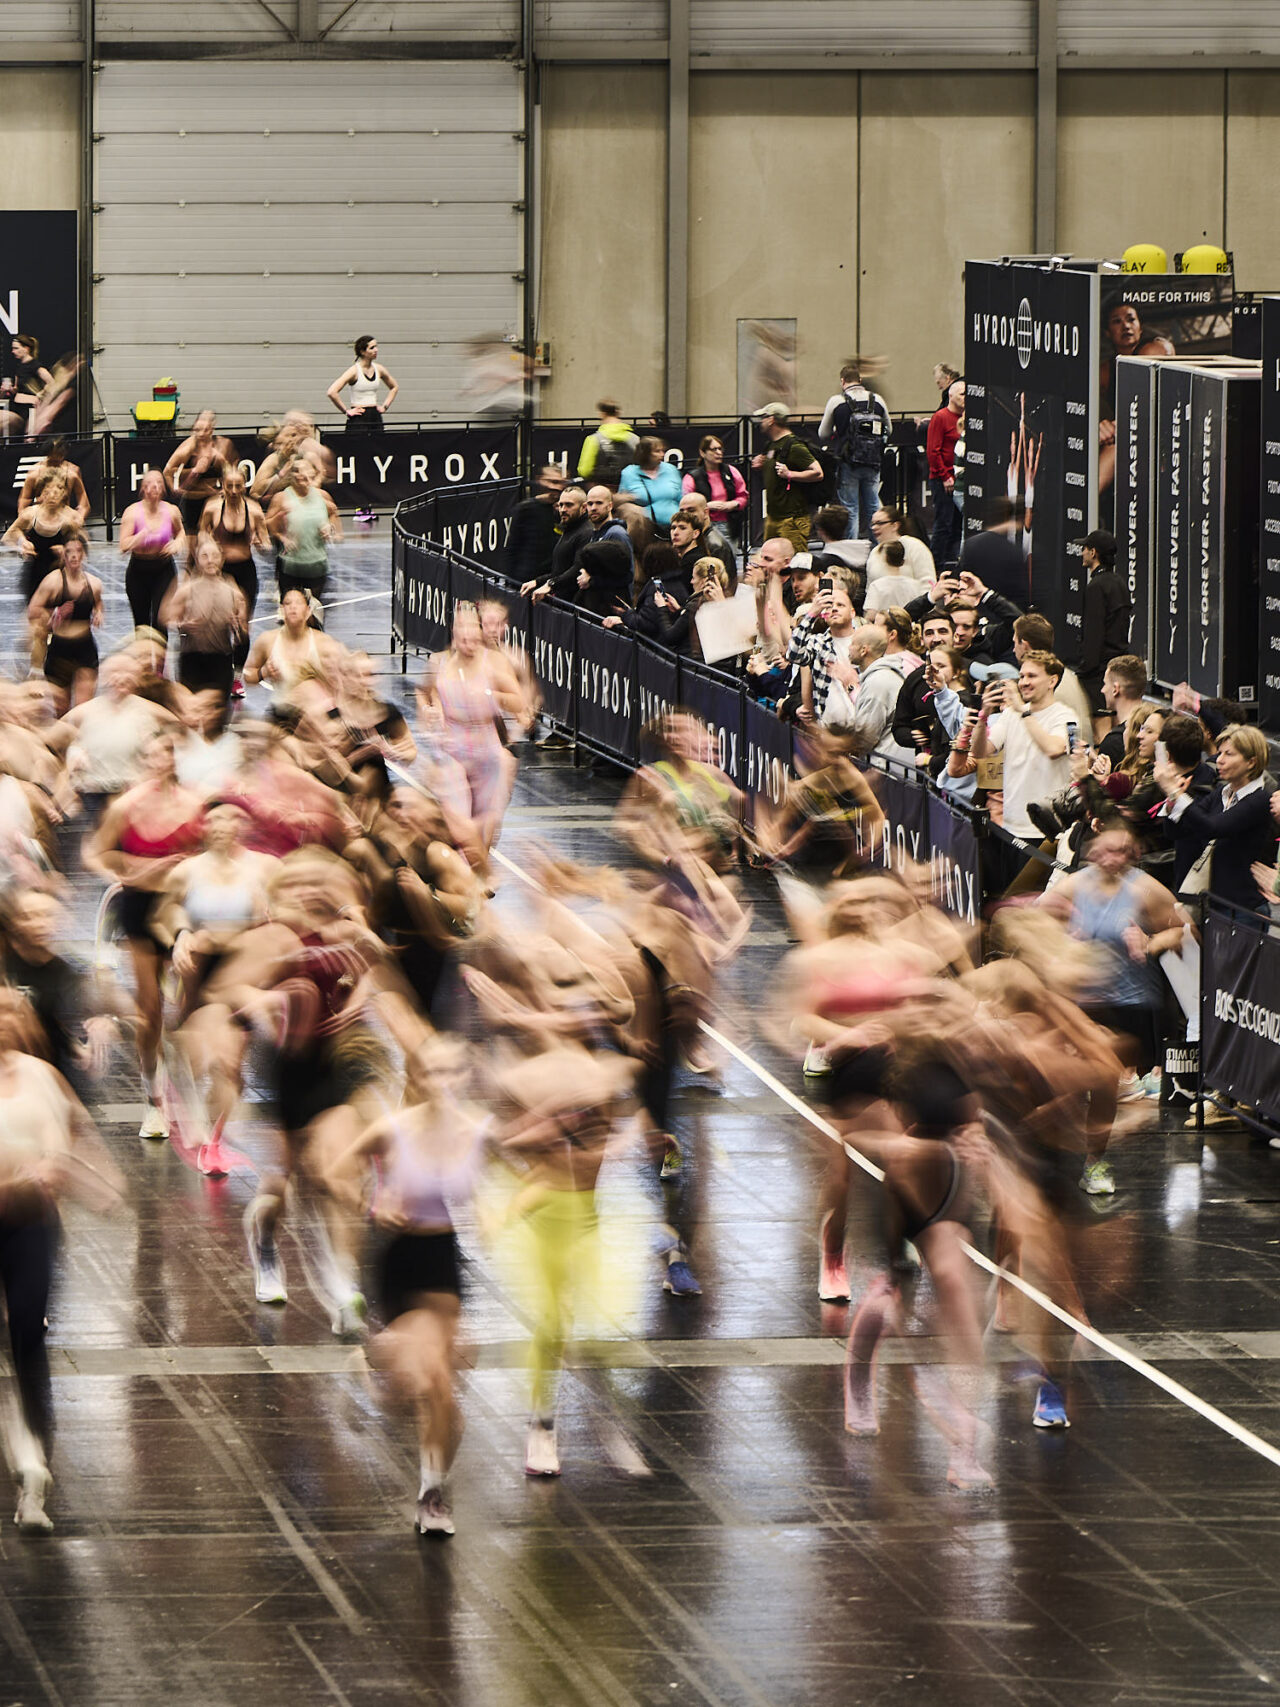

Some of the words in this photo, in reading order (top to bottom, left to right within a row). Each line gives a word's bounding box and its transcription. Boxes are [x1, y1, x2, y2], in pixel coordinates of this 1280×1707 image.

[1122, 291, 1156, 303] MADE
[1158, 291, 1182, 303] FOR
[1184, 291, 1211, 303] THIS
[1234, 306, 1257, 315] ROX
[974, 312, 1016, 347] HYROX
[1033, 320, 1080, 357] WORLD
[336, 452, 501, 484] HYROX
[408, 578, 448, 627] HYROX
[534, 635, 574, 691] HYROX
[581, 657, 631, 719] HYROX
